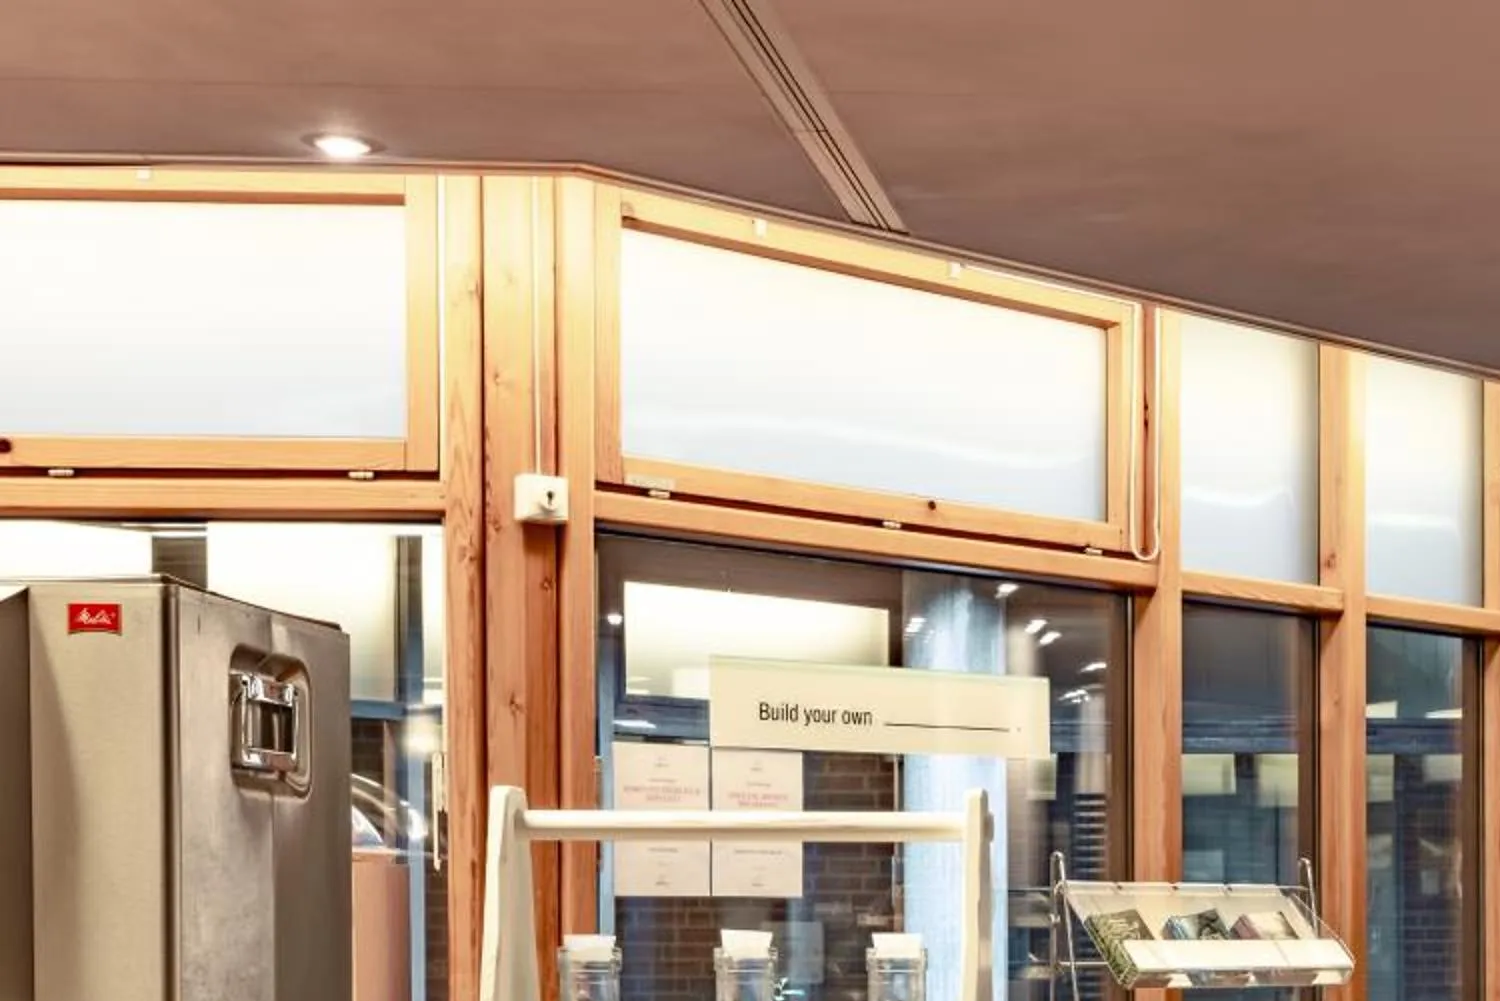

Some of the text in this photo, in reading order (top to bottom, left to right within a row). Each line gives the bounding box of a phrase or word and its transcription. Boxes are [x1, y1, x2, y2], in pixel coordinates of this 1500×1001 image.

[758, 702, 873, 727] Build your own
